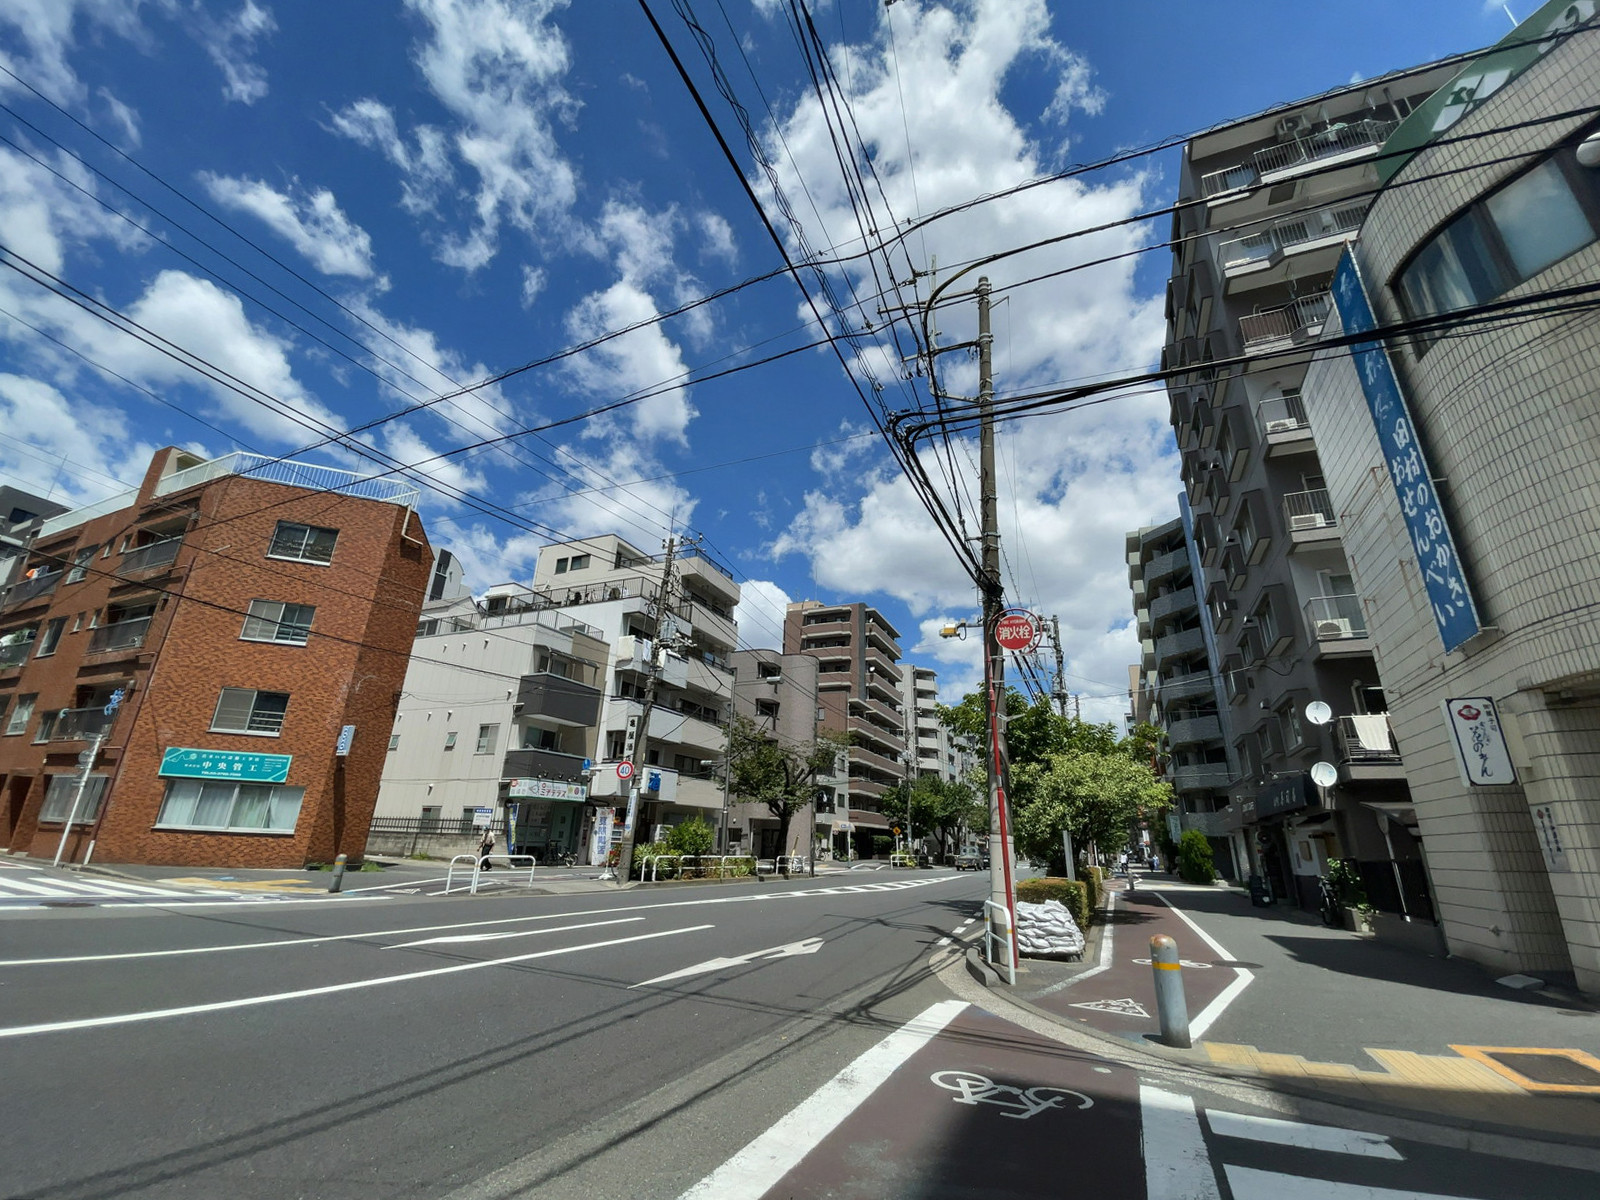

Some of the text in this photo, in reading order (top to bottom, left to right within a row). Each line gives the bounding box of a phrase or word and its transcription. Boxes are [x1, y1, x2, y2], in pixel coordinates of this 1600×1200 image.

[1392, 416, 1465, 609] 田村のおかき
[1391, 459, 1456, 627] おせんべい
[998, 624, 1031, 641] 消火栓
[202, 760, 258, 772] 中央管工
[620, 765, 630, 775] 40
